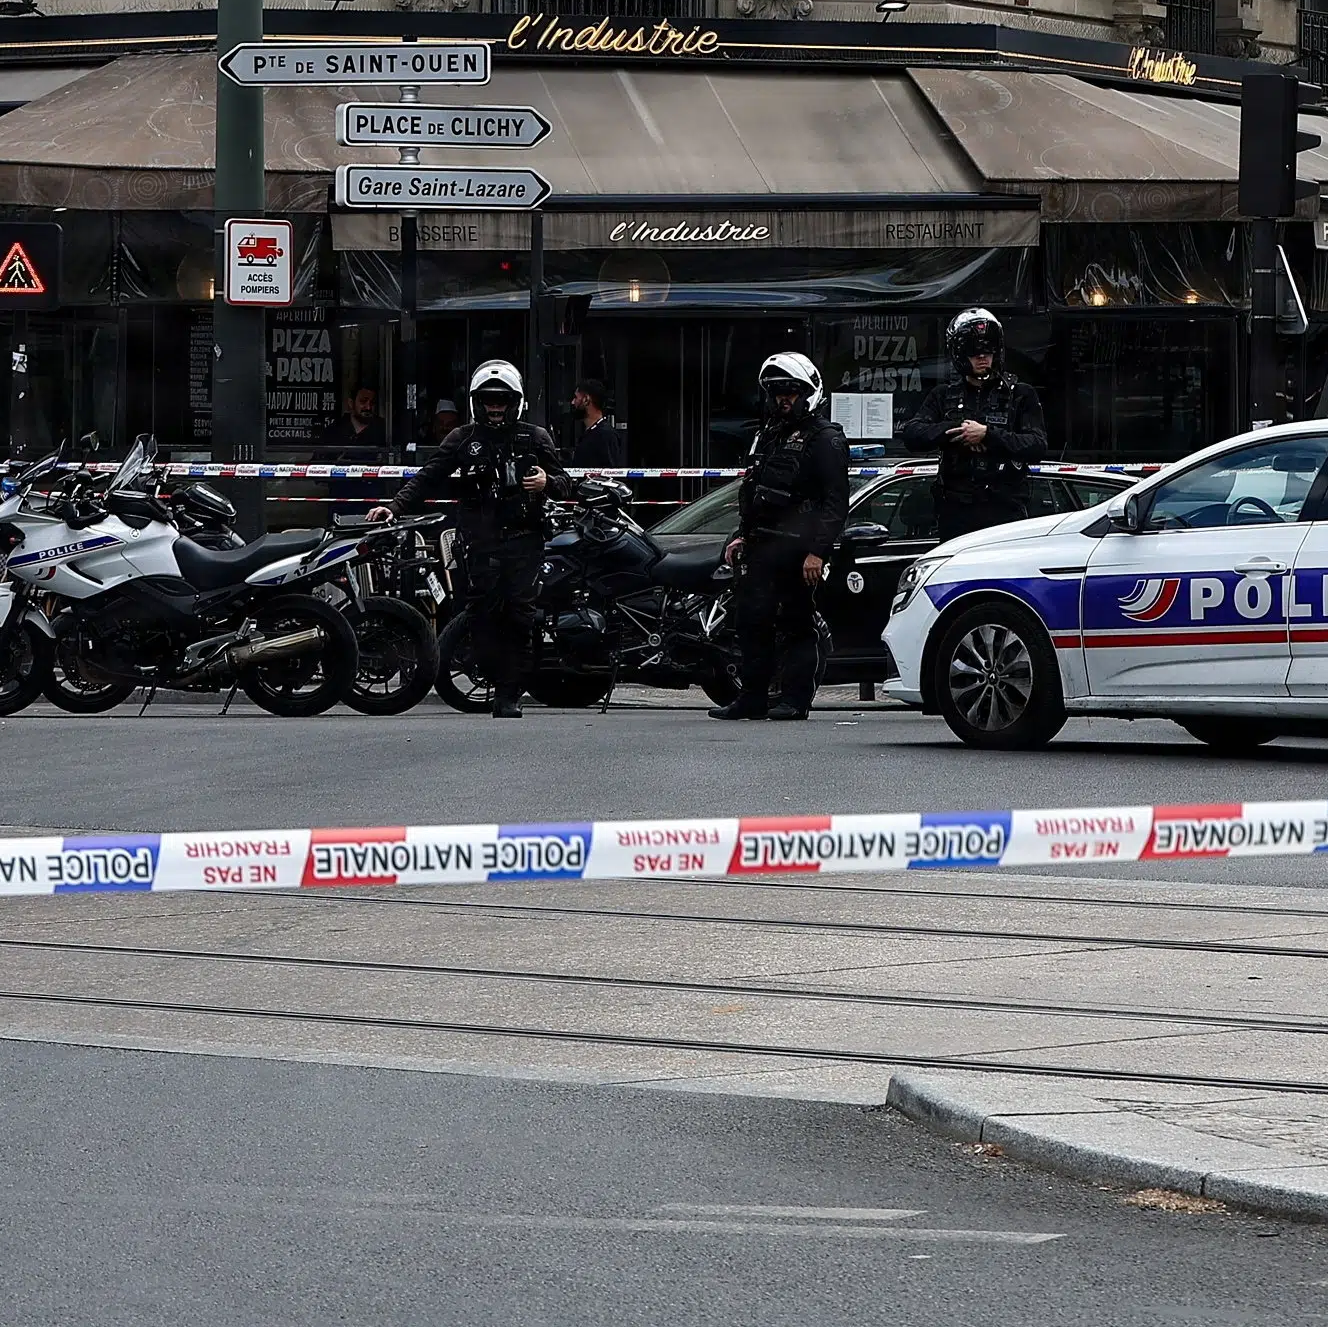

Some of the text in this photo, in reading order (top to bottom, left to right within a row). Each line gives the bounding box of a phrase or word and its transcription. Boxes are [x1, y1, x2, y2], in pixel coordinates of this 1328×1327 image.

[507, 15, 721, 55] l'Industrie
[295, 54, 478, 74] DE SAINT-OUEN
[355, 114, 525, 137] PLACE DE CLICHY
[358, 176, 526, 199] Gare Saint-Lazare
[389, 225, 478, 242] BSSERIE
[609, 219, 770, 243] l'Industrie
[885, 222, 985, 240] RESTAURANT
[247, 273, 273, 282] ACCÈS
[240, 285, 280, 295] POMPIERS
[272, 328, 332, 353] PIZZA
[853, 335, 918, 362] PIZZA
[276, 358, 334, 383] PASTA
[858, 366, 922, 392] PASTA
[266, 391, 319, 411] HAPPY HOUR
[268, 429, 312, 439] COCKTAILS
[38, 542, 84, 560] POLICE
[1035, 816, 1134, 834] FRANCHIR
[1155, 817, 1304, 848] NATIONALE
[619, 828, 721, 849] FRANCHIR
[742, 824, 1004, 863] POLICE NATIONALE
[185, 840, 291, 859] FRANCHIR
[316, 836, 583, 875] POLICE NATIONALE
[1049, 841, 1119, 859] NE PAS
[46, 848, 152, 884] POLICE
[633, 851, 705, 872] NE PAS
[203, 863, 276, 885] NE PAS
